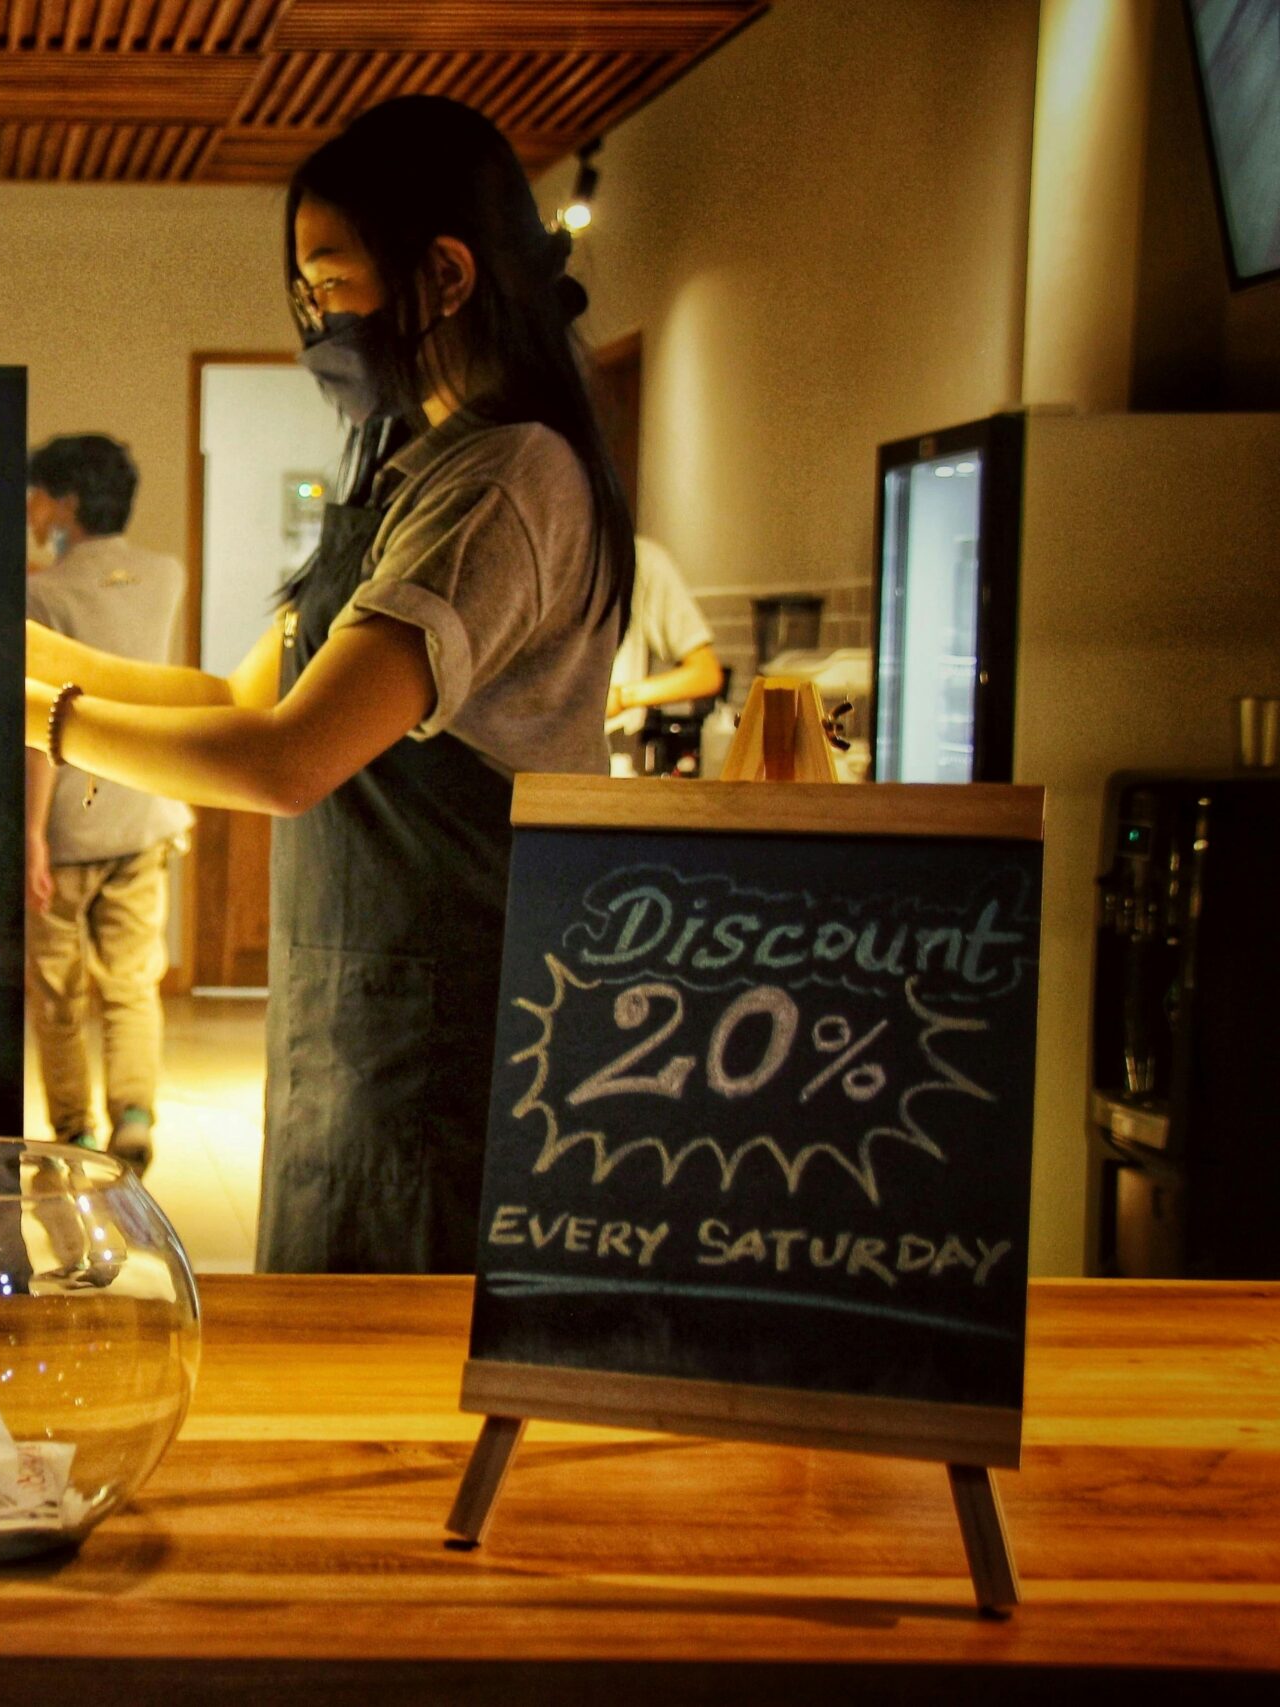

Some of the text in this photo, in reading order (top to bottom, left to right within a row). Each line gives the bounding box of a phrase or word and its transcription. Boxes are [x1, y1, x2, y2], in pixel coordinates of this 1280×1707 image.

[581, 887, 1025, 983] Discount
[566, 984, 888, 1105] 20%
[488, 1206, 1011, 1286] EVERY SATURDAY
